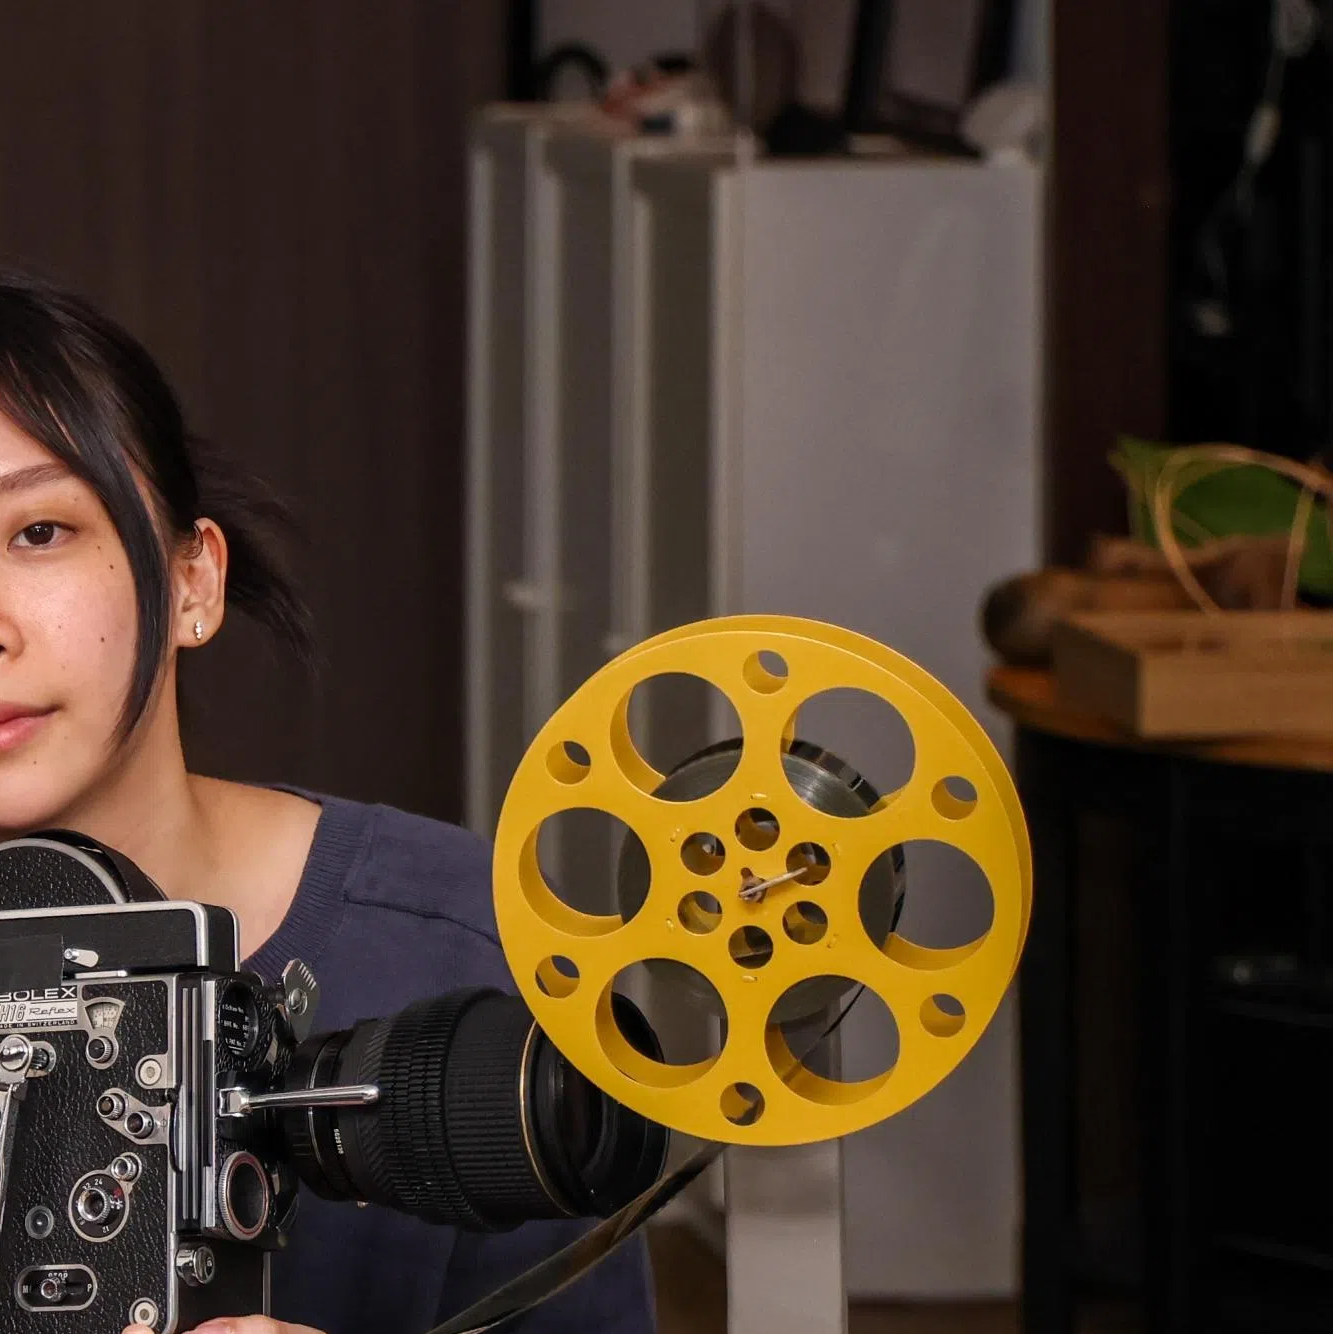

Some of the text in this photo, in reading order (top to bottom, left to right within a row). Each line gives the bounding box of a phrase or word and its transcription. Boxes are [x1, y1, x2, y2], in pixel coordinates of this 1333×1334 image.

[0, 1004, 75, 1022] H16 Reflex
[27, 1019, 76, 1028] SWITZERLAND
[94, 1178, 103, 1186] 24
[87, 1283, 93, 1292] P
